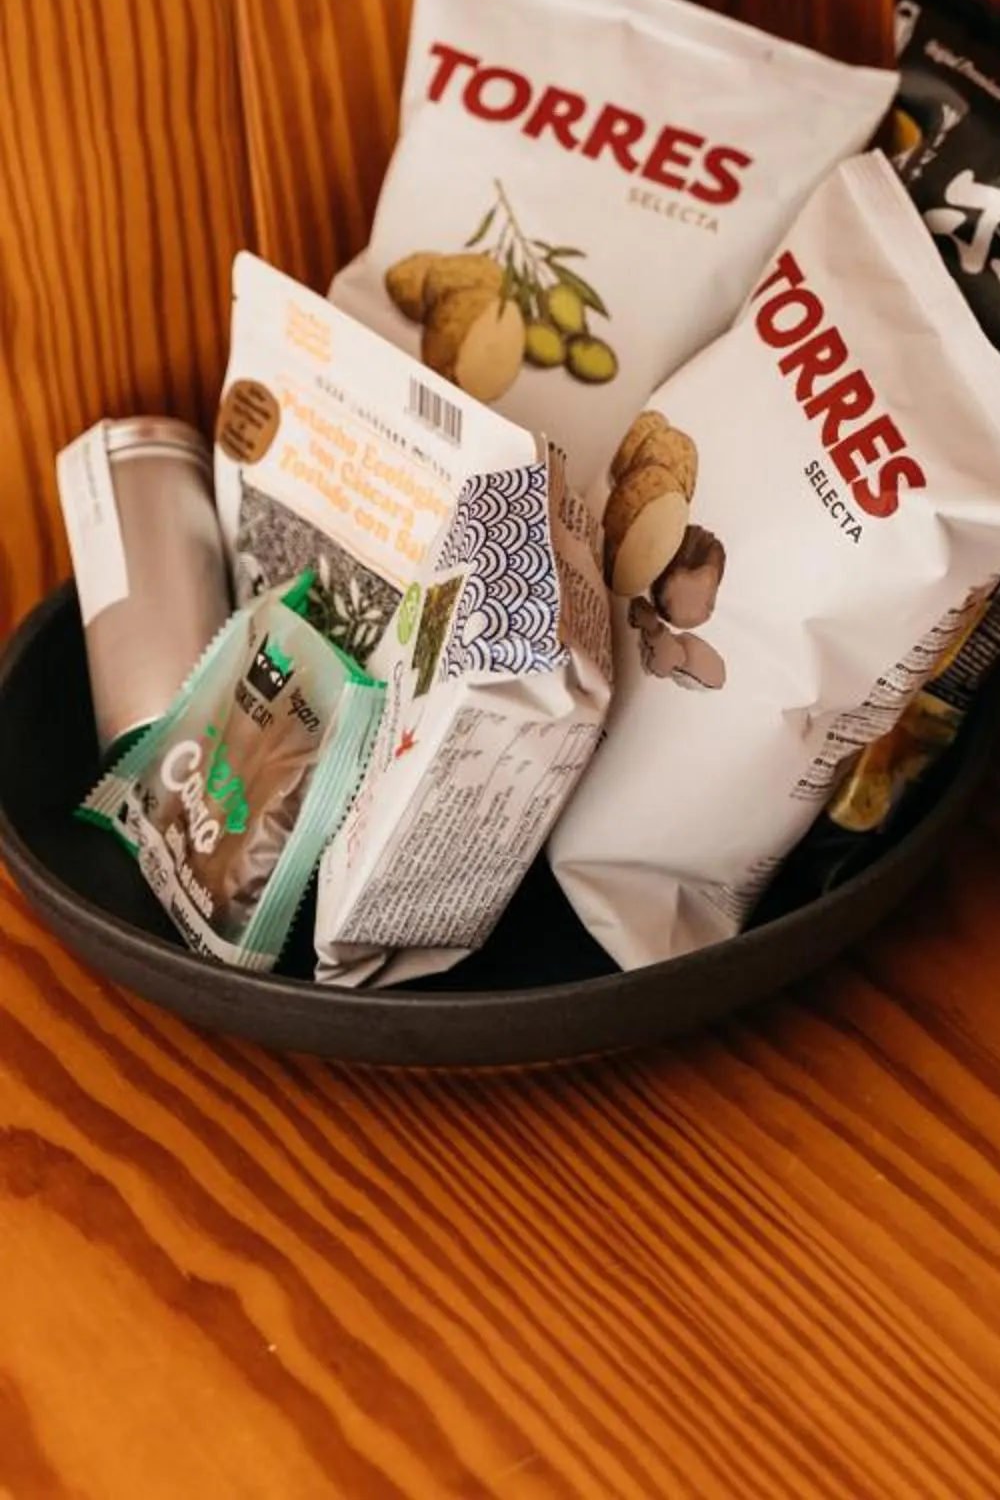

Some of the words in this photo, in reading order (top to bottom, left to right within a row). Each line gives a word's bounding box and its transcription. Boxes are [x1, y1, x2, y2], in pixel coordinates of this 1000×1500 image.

[426, 42, 754, 209] TORRES
[627, 185, 721, 236] SELECTA
[749, 249, 927, 519] TORRES
[803, 459, 864, 544] SELECTA
